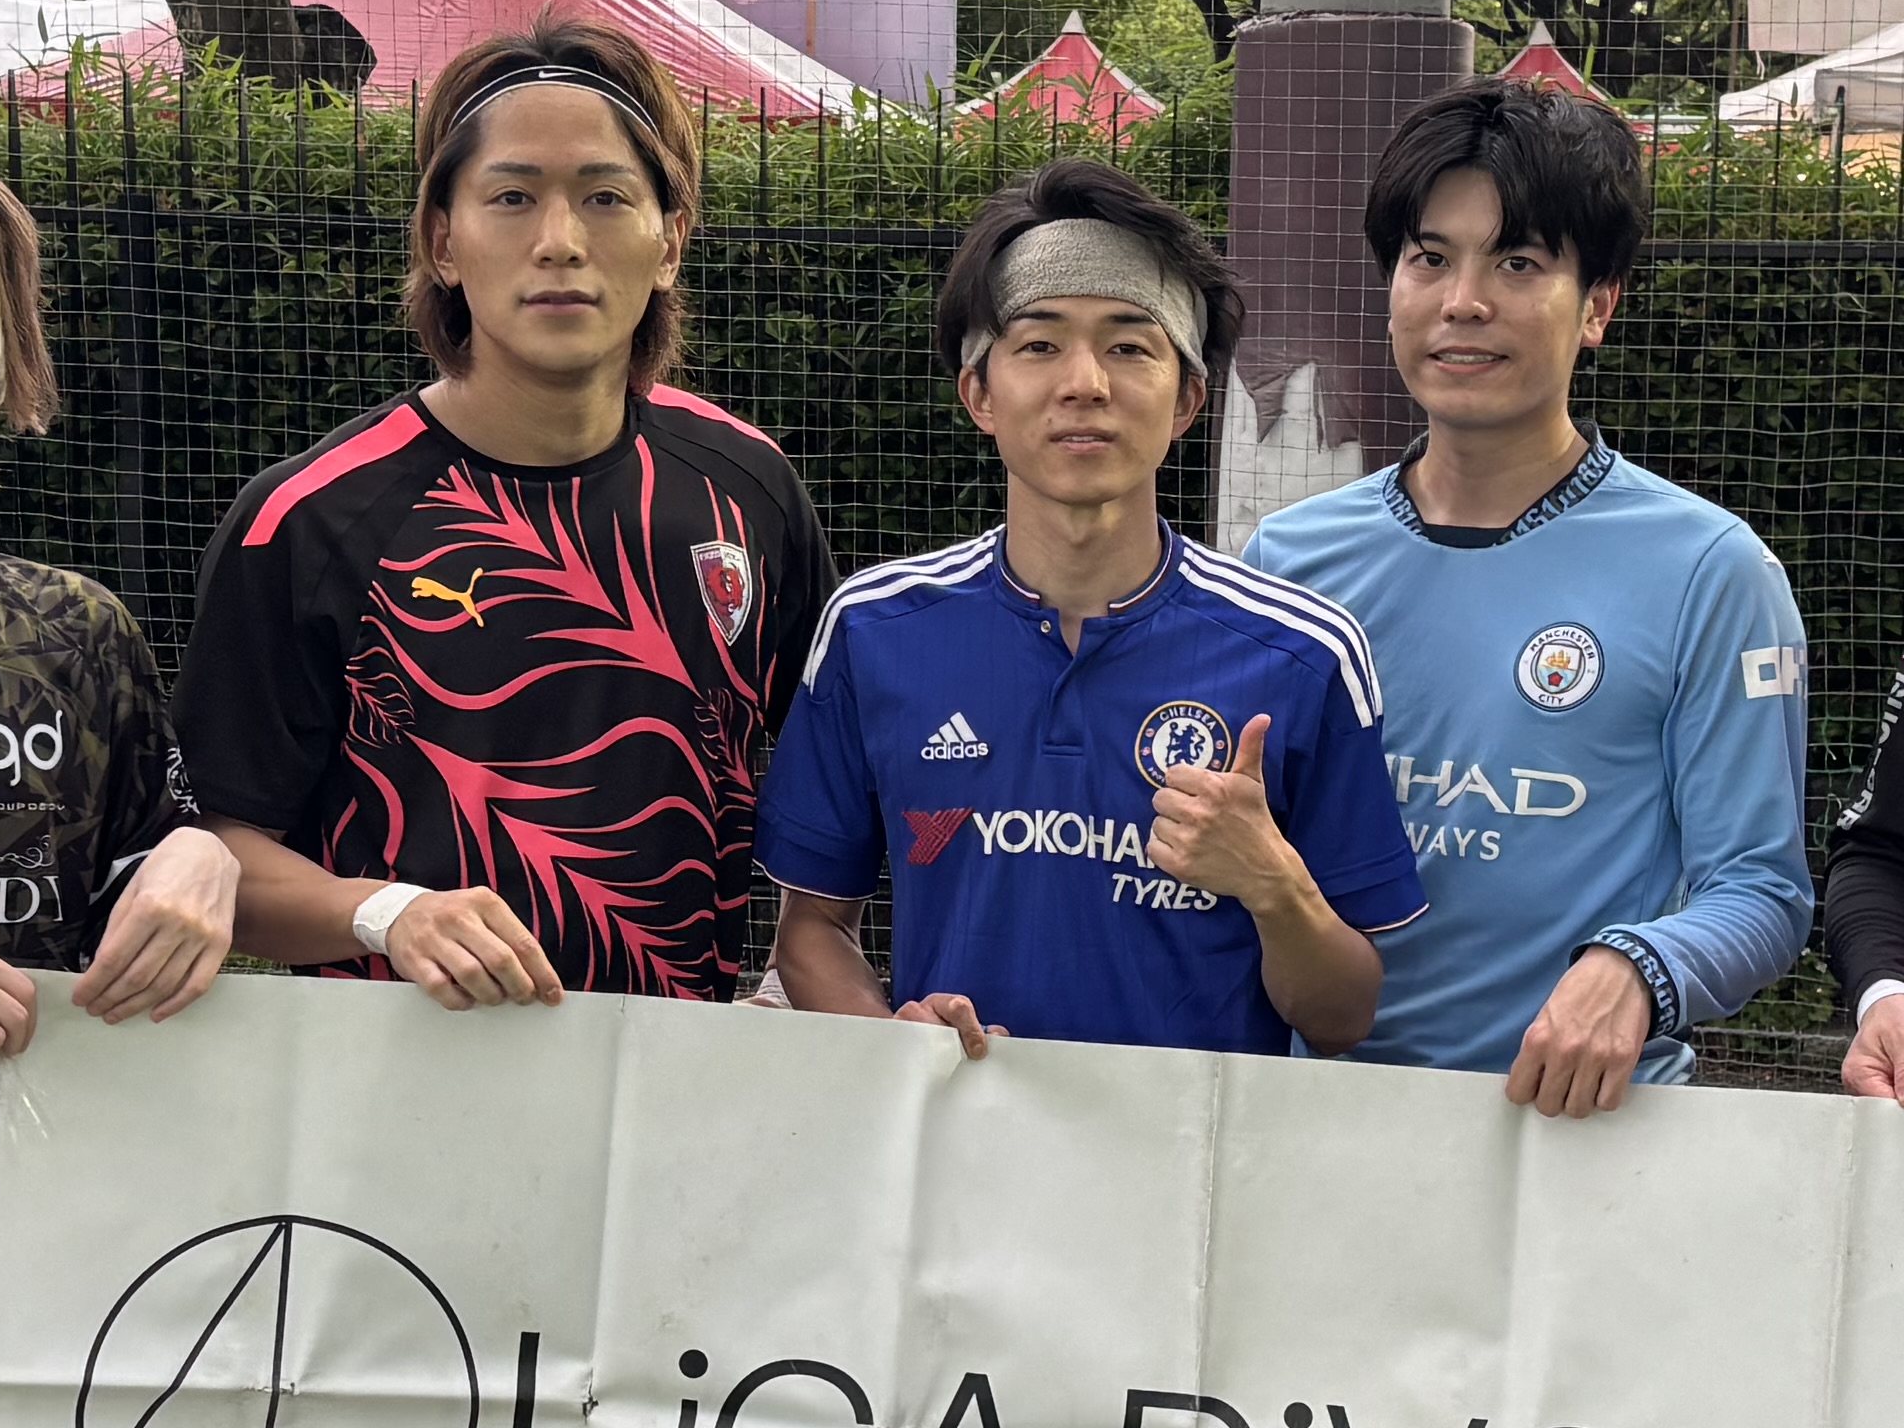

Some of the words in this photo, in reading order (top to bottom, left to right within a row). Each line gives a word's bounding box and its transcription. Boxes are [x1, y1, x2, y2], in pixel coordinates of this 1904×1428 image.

[1529, 629, 1596, 660] MANCHESTER
[1538, 694, 1564, 706] CITY
[1159, 706, 1217, 731] CHELSEA
[921, 739, 989, 761] adidas
[1385, 753, 1587, 817] HAD
[972, 809, 1156, 870] YOKOHA
[1403, 822, 1501, 861] WAYS
[1112, 873, 1218, 911] TYRES
